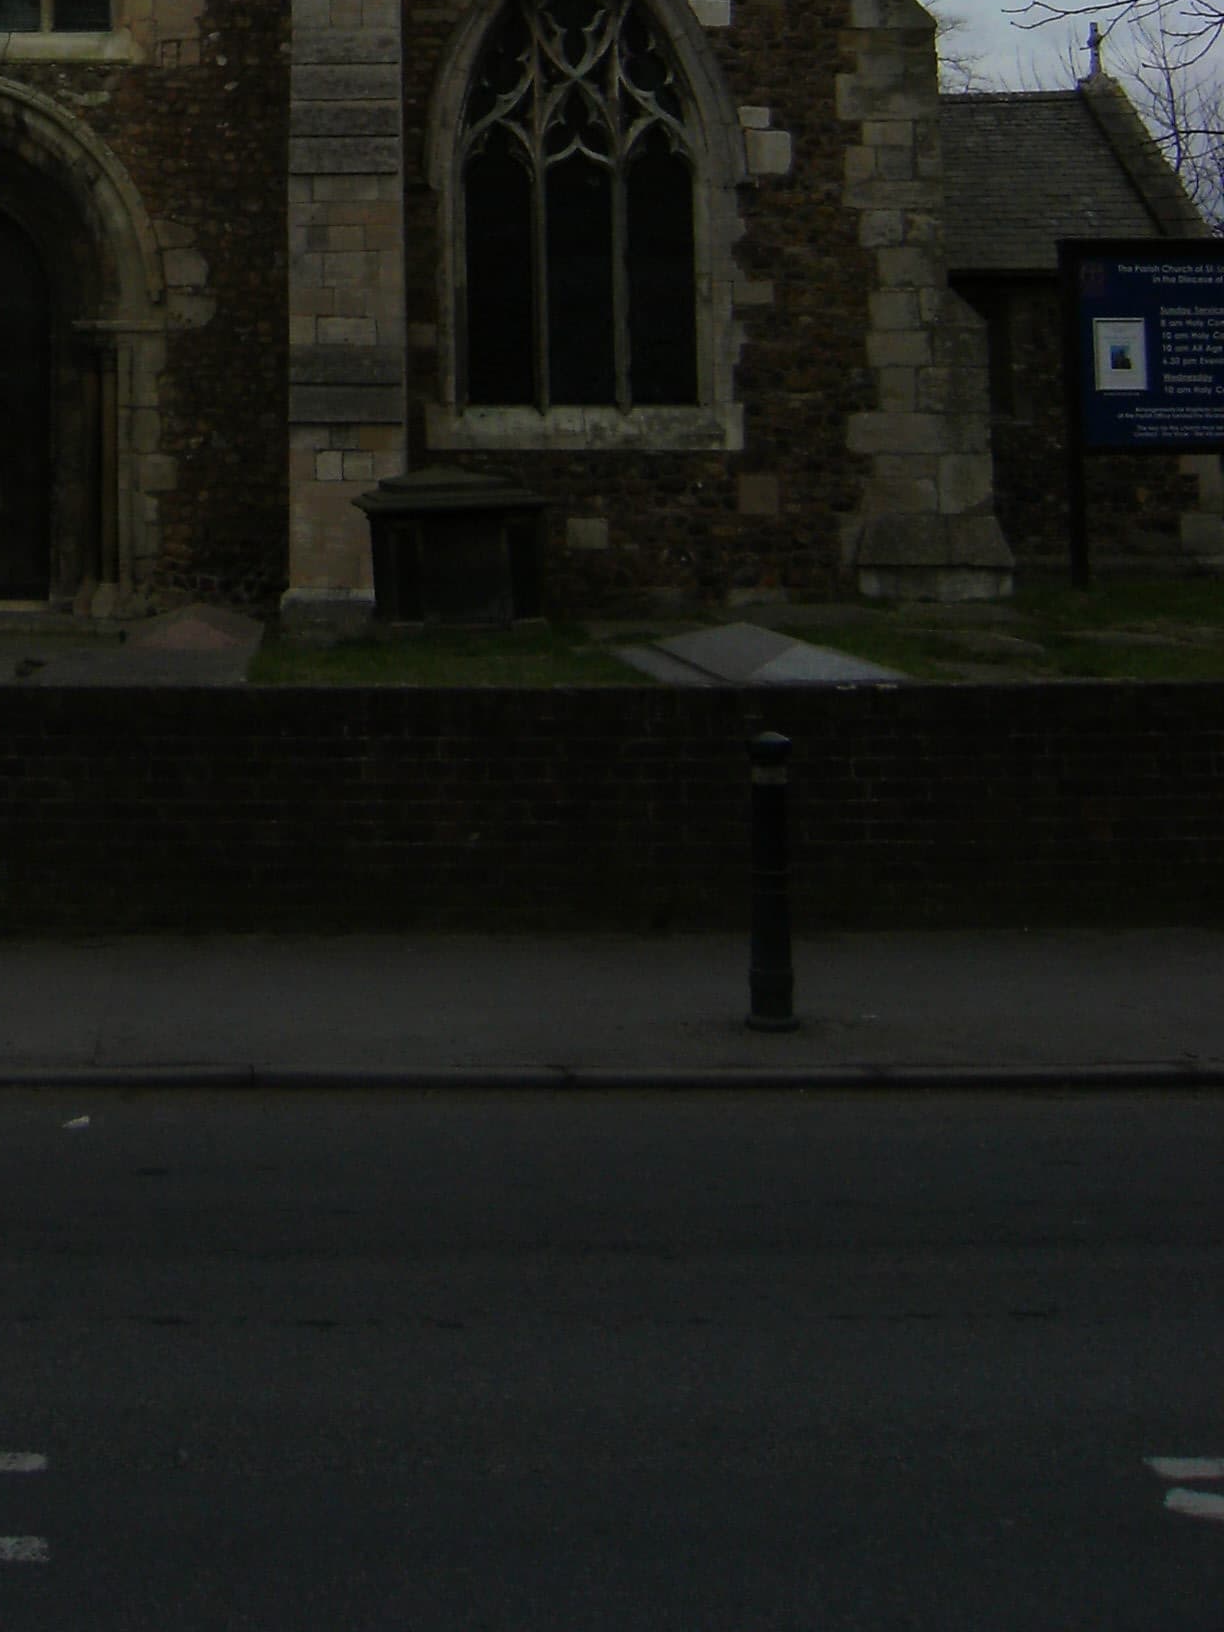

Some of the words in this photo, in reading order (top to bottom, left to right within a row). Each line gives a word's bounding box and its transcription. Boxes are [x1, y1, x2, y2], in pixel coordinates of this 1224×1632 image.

[1118, 264, 1133, 273] The
[1135, 264, 1160, 273] Parish
[1162, 264, 1193, 273] Church
[1194, 264, 1203, 273] of
[1153, 274, 1161, 284] in
[1162, 275, 1176, 284] the
[1178, 275, 1213, 284] Diocese
[1215, 275, 1223, 284] of
[1160, 306, 1191, 316] Sunday
[1185, 319, 1203, 329] Holy
[1162, 331, 1172, 339] 10
[1192, 331, 1209, 341] Holy
[1162, 344, 1172, 352] 10
[1182, 358, 1197, 367] pm
[1164, 385, 1174, 393] 10
[1193, 385, 1212, 395] Holy
